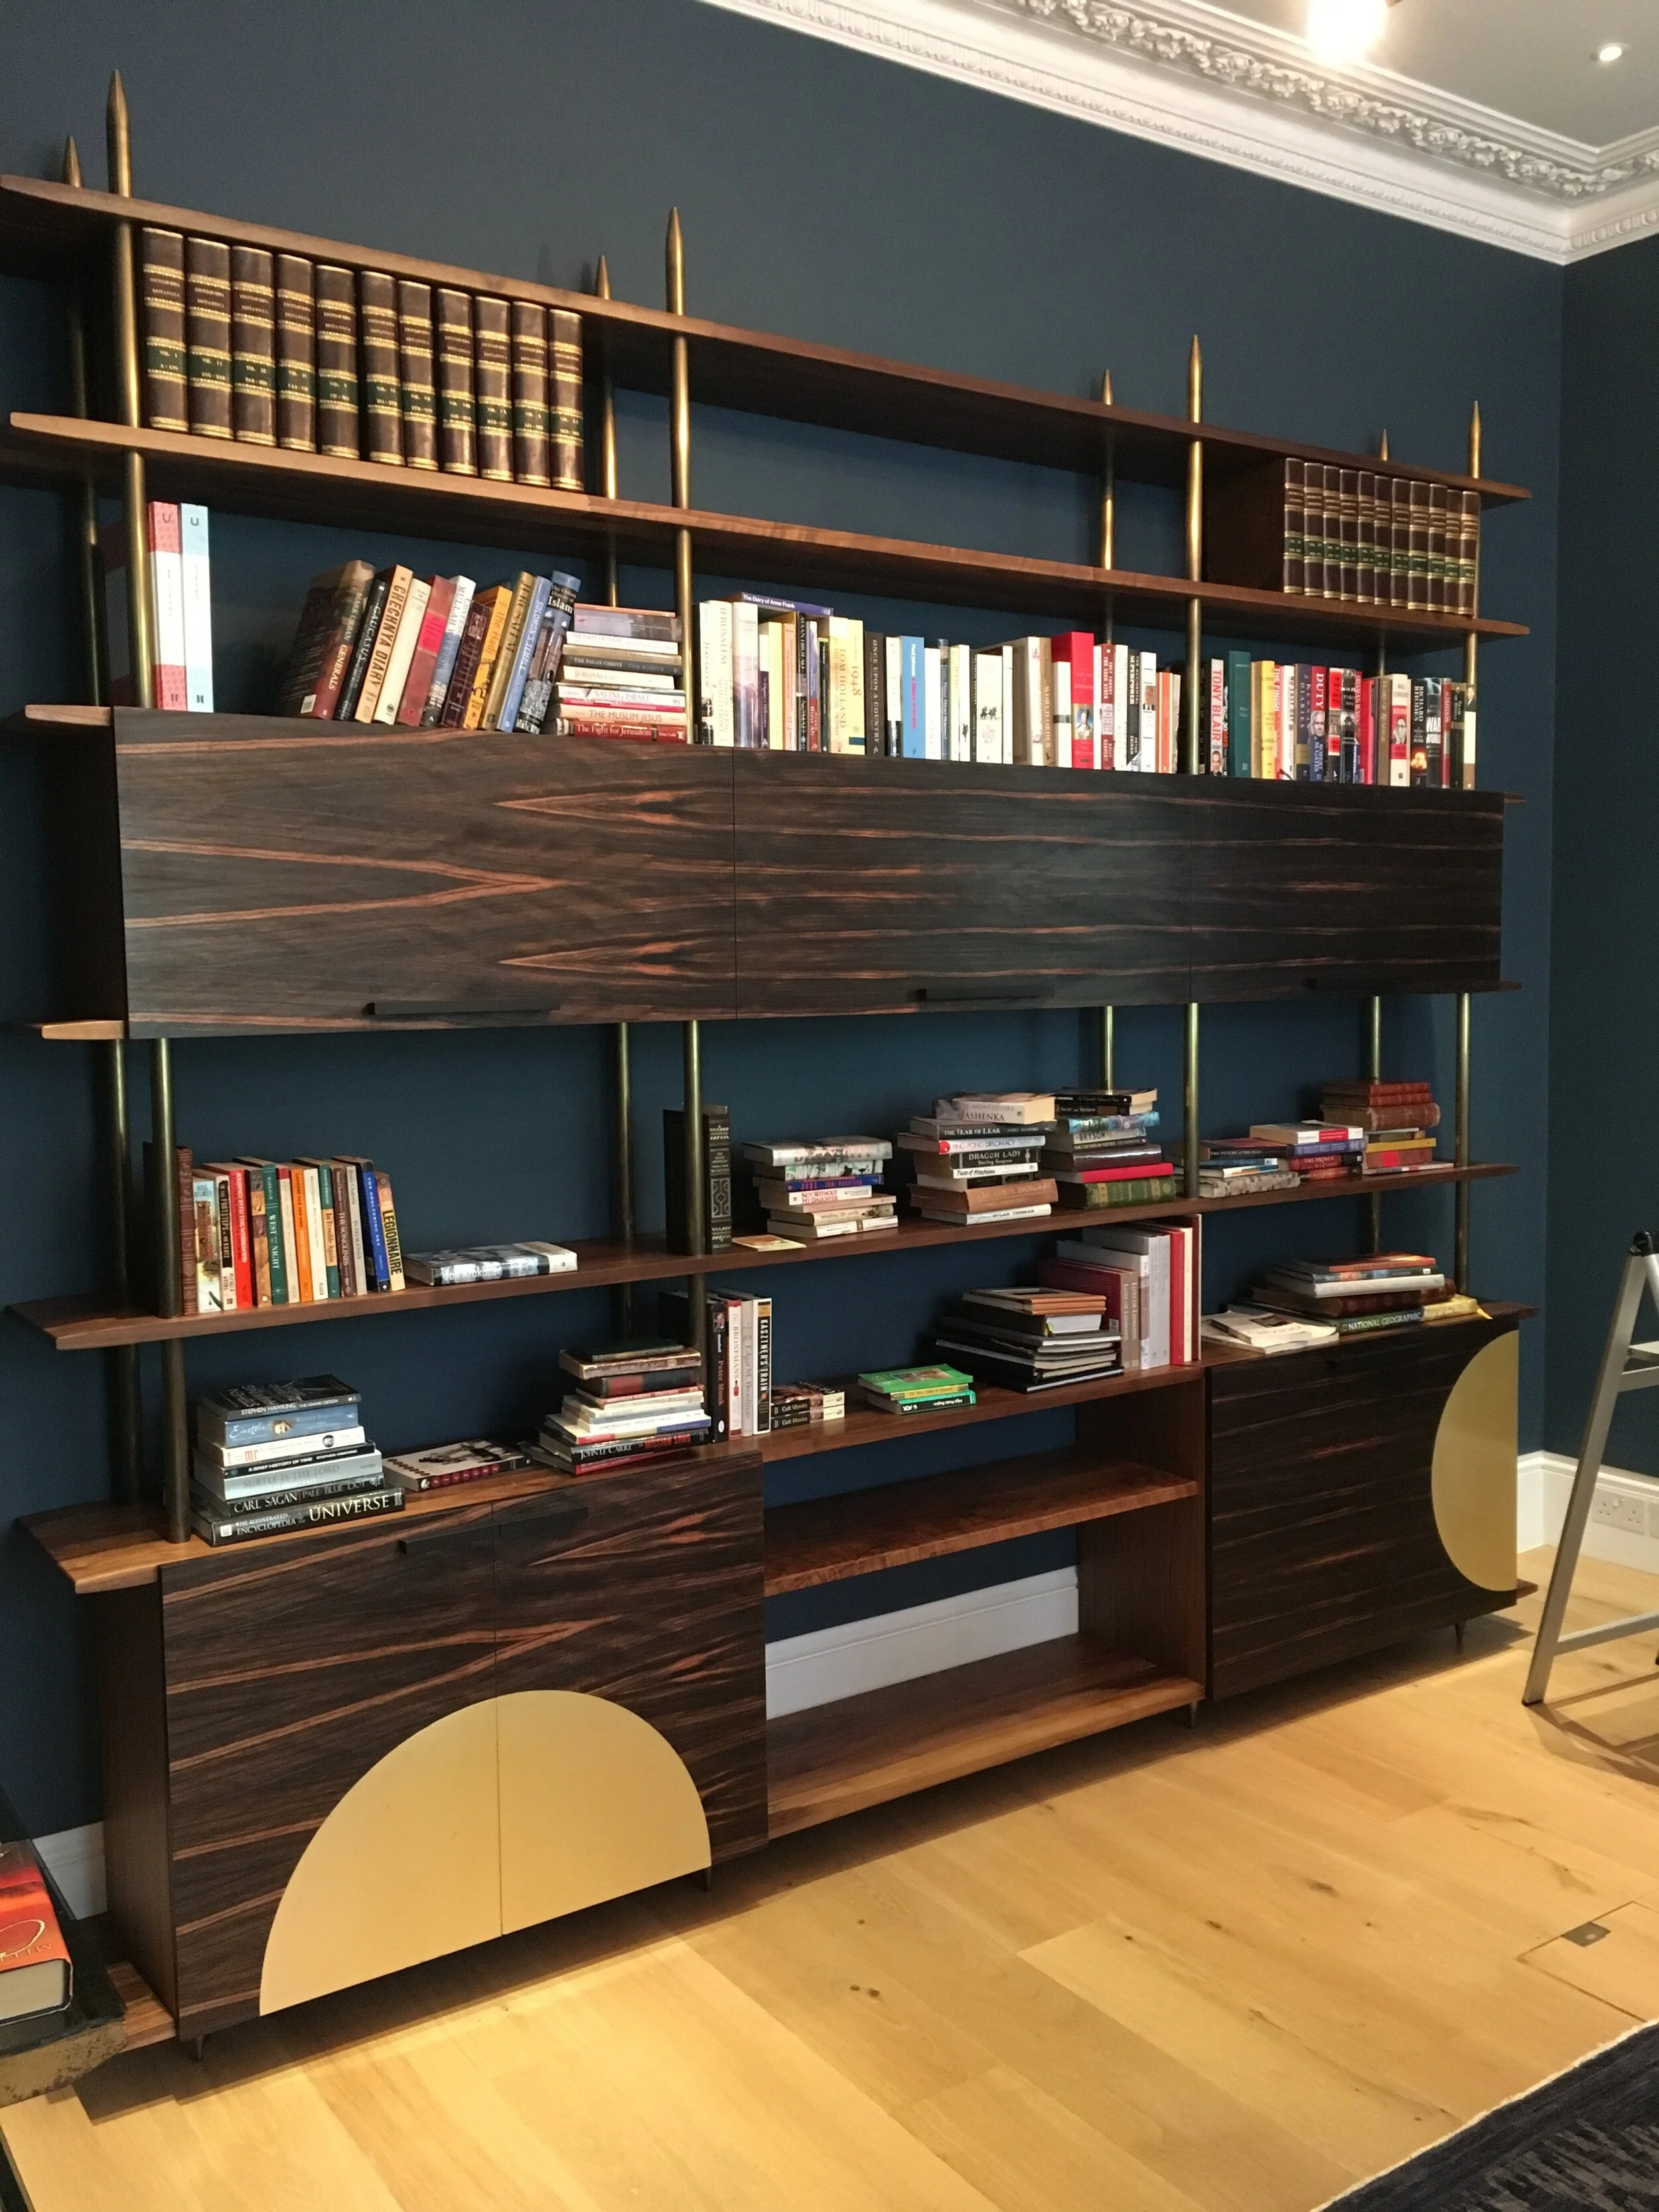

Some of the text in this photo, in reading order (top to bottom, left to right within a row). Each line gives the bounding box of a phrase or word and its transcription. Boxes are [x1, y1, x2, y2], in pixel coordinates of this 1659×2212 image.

[547, 595, 573, 614] Islam
[378, 584, 407, 650] CHECHNYA
[328, 644, 348, 690] GENERALS
[369, 650, 388, 686] DIARY
[850, 666, 862, 696] 1948
[595, 690, 650, 701] SAVING ISRAEL
[1212, 670, 1222, 741] TONY BLAIR
[589, 709, 662, 722] THE MUSLIM JESUS
[576, 724, 590, 733] The
[591, 725, 608, 735] Fight
[619, 726, 652, 737] Jerusalem
[1080, 1132, 1106, 1141] BRYSON
[968, 1151, 1000, 1160] DRAGON
[369, 1192, 379, 1232] SHELTERING
[339, 1226, 348, 1266] SONGLINES
[382, 1210, 402, 1276] LEGIONNAIRE
[1348, 1311, 1421, 1331] NATIONAL GEOGRAPHIC
[760, 1319, 768, 1365] KASZTNER'S
[241, 1403, 297, 1416] STEPHEN HAWKING
[230, 1423, 266, 1439] Einstein
[644, 1434, 691, 1449] MISSION SONG
[269, 1461, 292, 1470] HISTORY
[244, 1476, 277, 1487] SUBTLE
[293, 1469, 311, 1479] THE
[314, 1465, 340, 1475] LORD
[302, 1481, 366, 1499] PALE BLUE DOT
[234, 1493, 298, 1514] CARL SAGAN
[309, 1495, 390, 1522] UNIVERSE
[237, 1518, 297, 1536] ENCYCLOPEDIA
[249, 1513, 288, 1524] ILLUSTRATED
